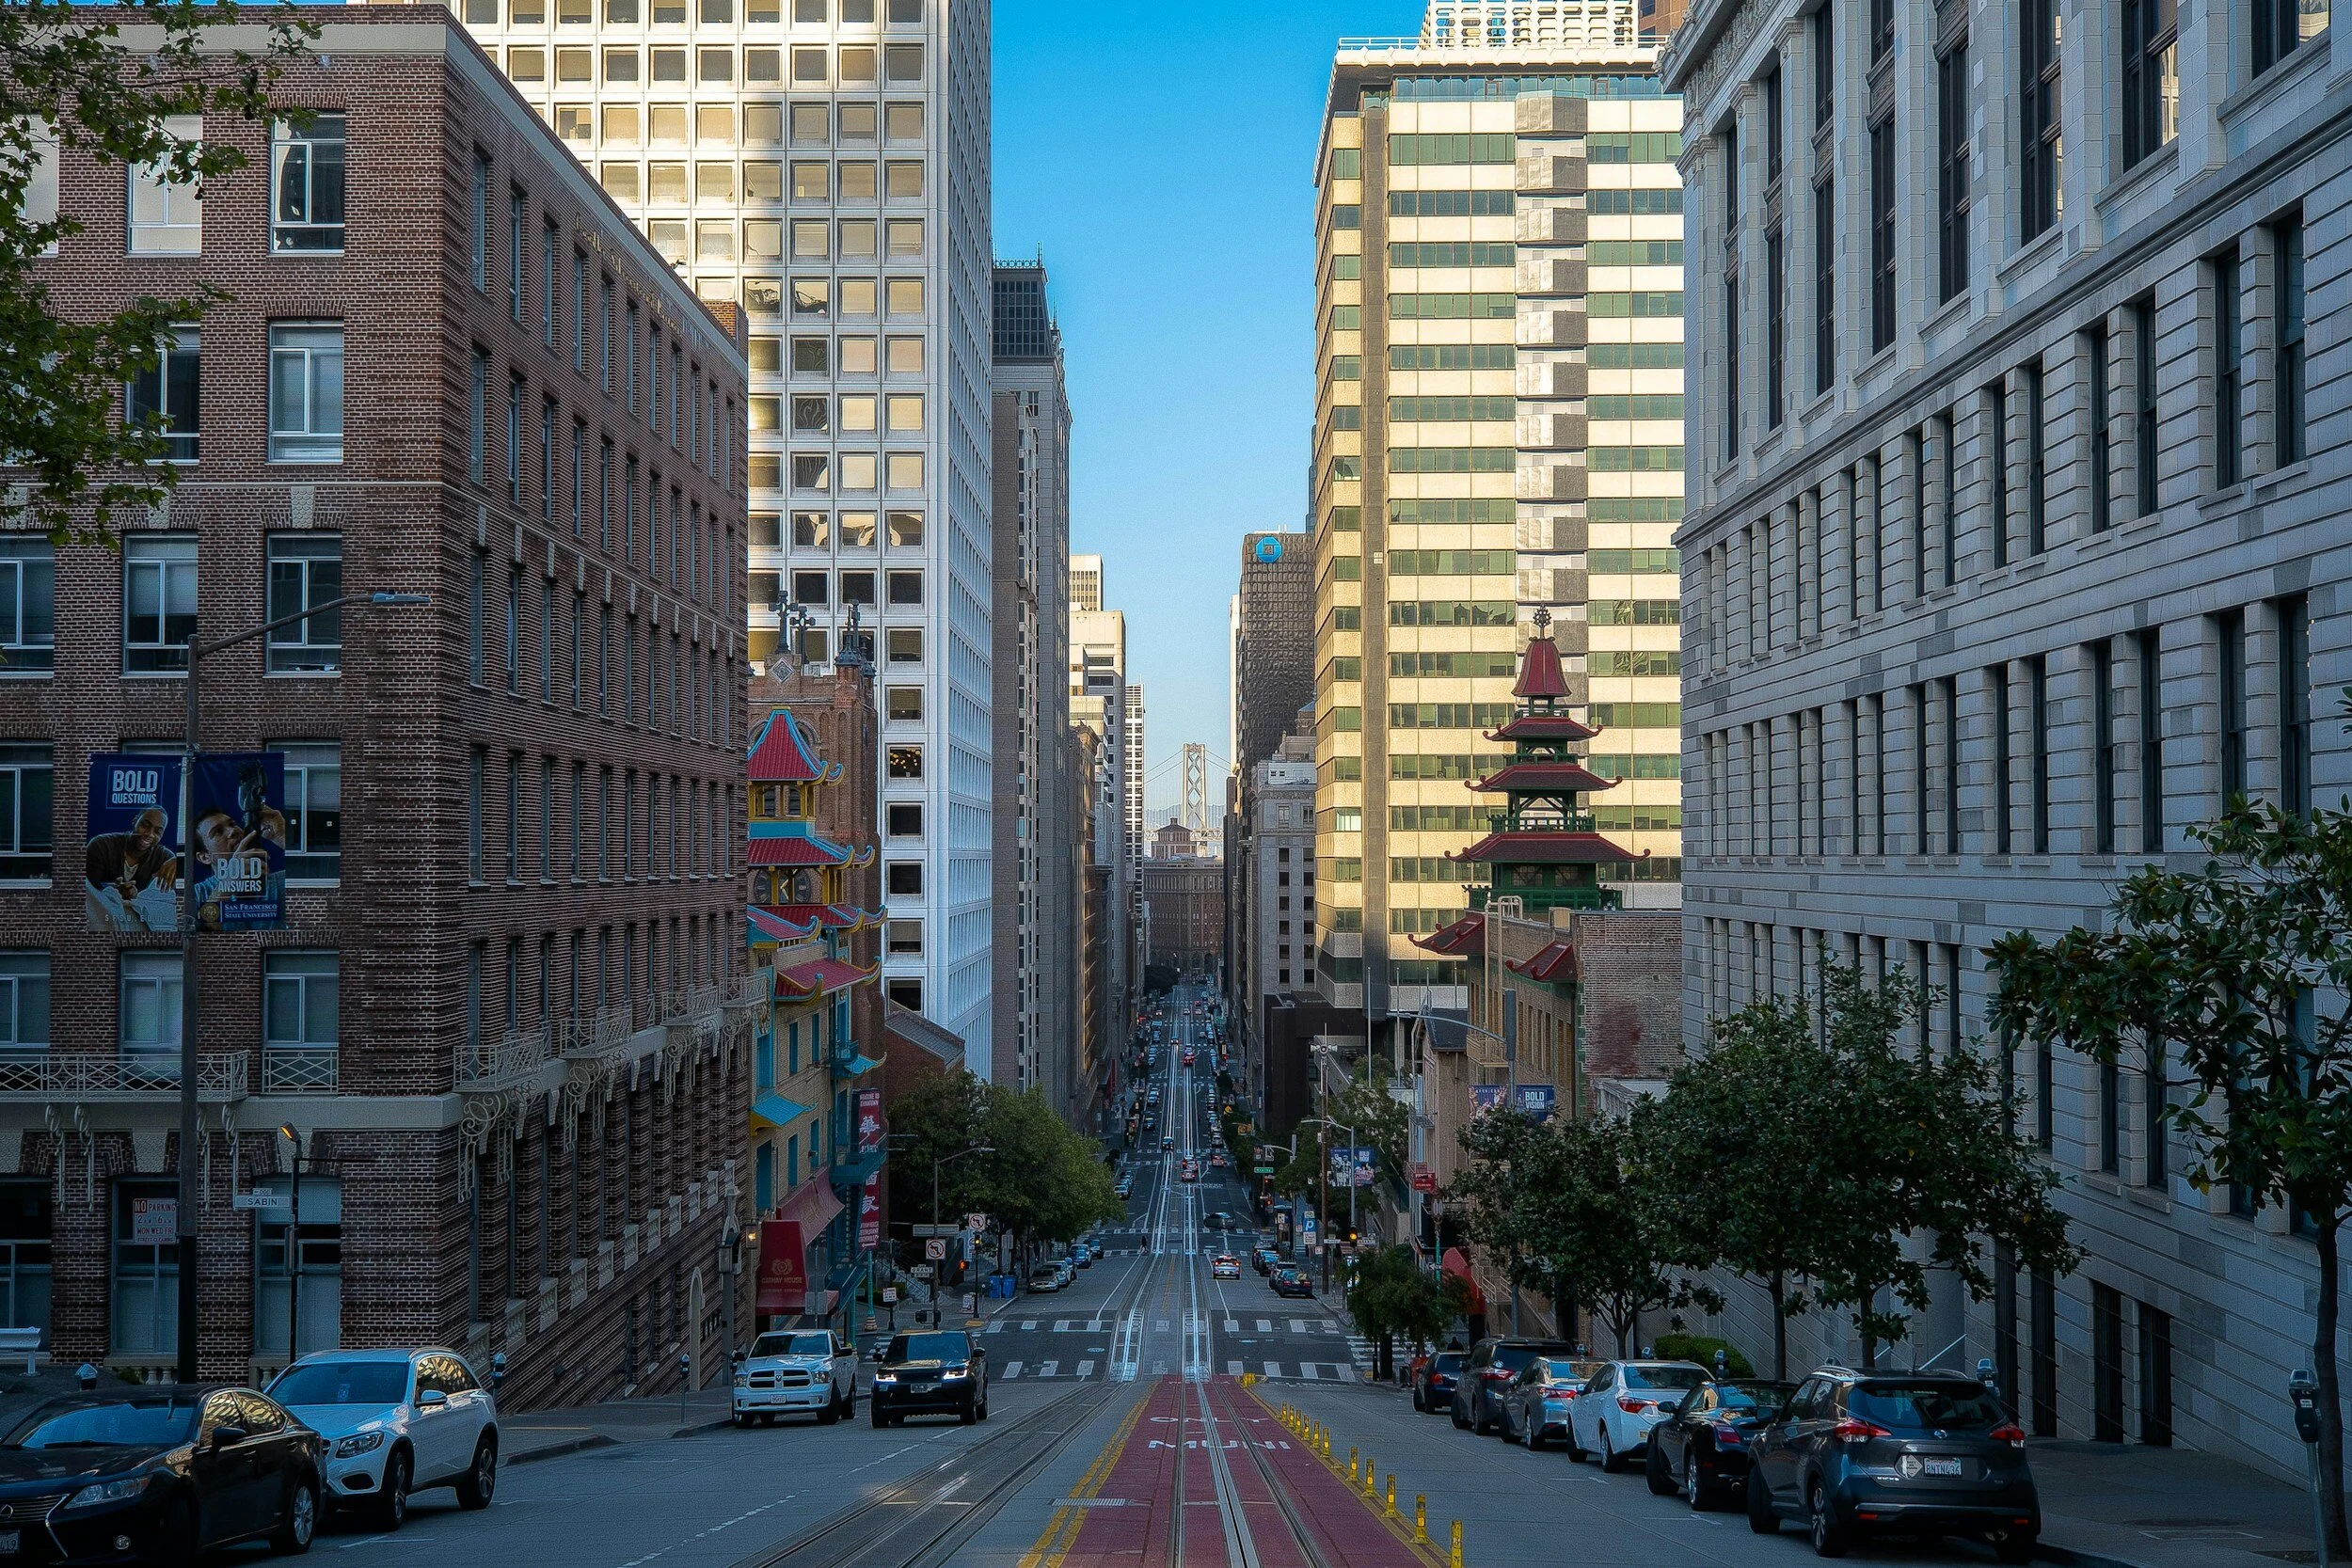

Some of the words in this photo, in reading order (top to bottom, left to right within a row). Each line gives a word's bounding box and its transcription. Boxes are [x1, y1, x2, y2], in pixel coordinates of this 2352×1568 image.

[113, 770, 158, 792] BOLD
[112, 793, 157, 804] QUESTIONS
[217, 857, 262, 879] BOLD
[218, 879, 262, 893] ANSWERS
[1525, 1091, 1545, 1101] BOLD
[135, 1200, 147, 1212] NO
[149, 1203, 176, 1212] PARKING
[247, 1197, 278, 1206] SABIN
[151, 1227, 164, 1235] WED
[1148, 1439, 1292, 1449] MUNI
